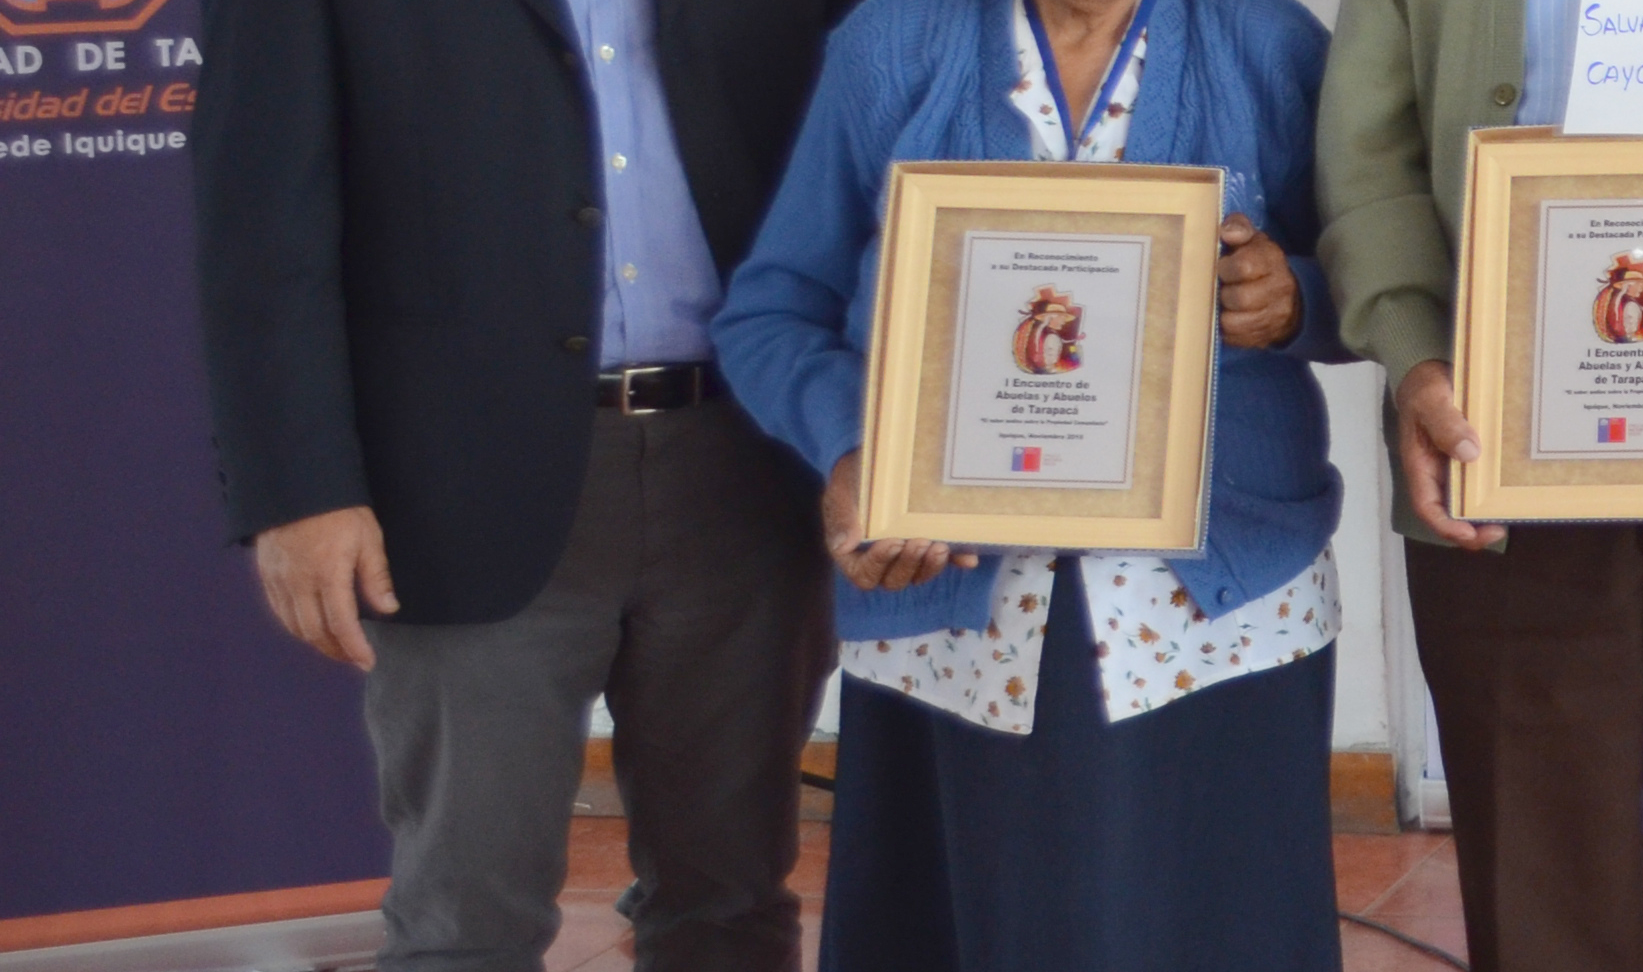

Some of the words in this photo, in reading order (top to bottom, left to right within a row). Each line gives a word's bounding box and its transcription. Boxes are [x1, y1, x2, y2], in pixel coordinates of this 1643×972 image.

[76, 42, 125, 71] DE
[156, 38, 203, 67] TA
[95, 85, 153, 116] del
[65, 130, 187, 158] Iquique
[1589, 231, 1634, 239] Destacada
[1587, 348, 1591, 357] I
[1578, 362, 1621, 370] Abuelas
[1625, 363, 1632, 372] y
[1005, 379, 1009, 388] I
[1013, 379, 1072, 389] Encuentro
[1076, 380, 1089, 389] de
[1595, 375, 1607, 384] de
[996, 391, 1039, 400] Abuelas
[1043, 394, 1049, 403] y
[1053, 393, 1096, 402] Abuelos
[1012, 405, 1024, 414] de
[1028, 405, 1078, 416] Tarapacá
